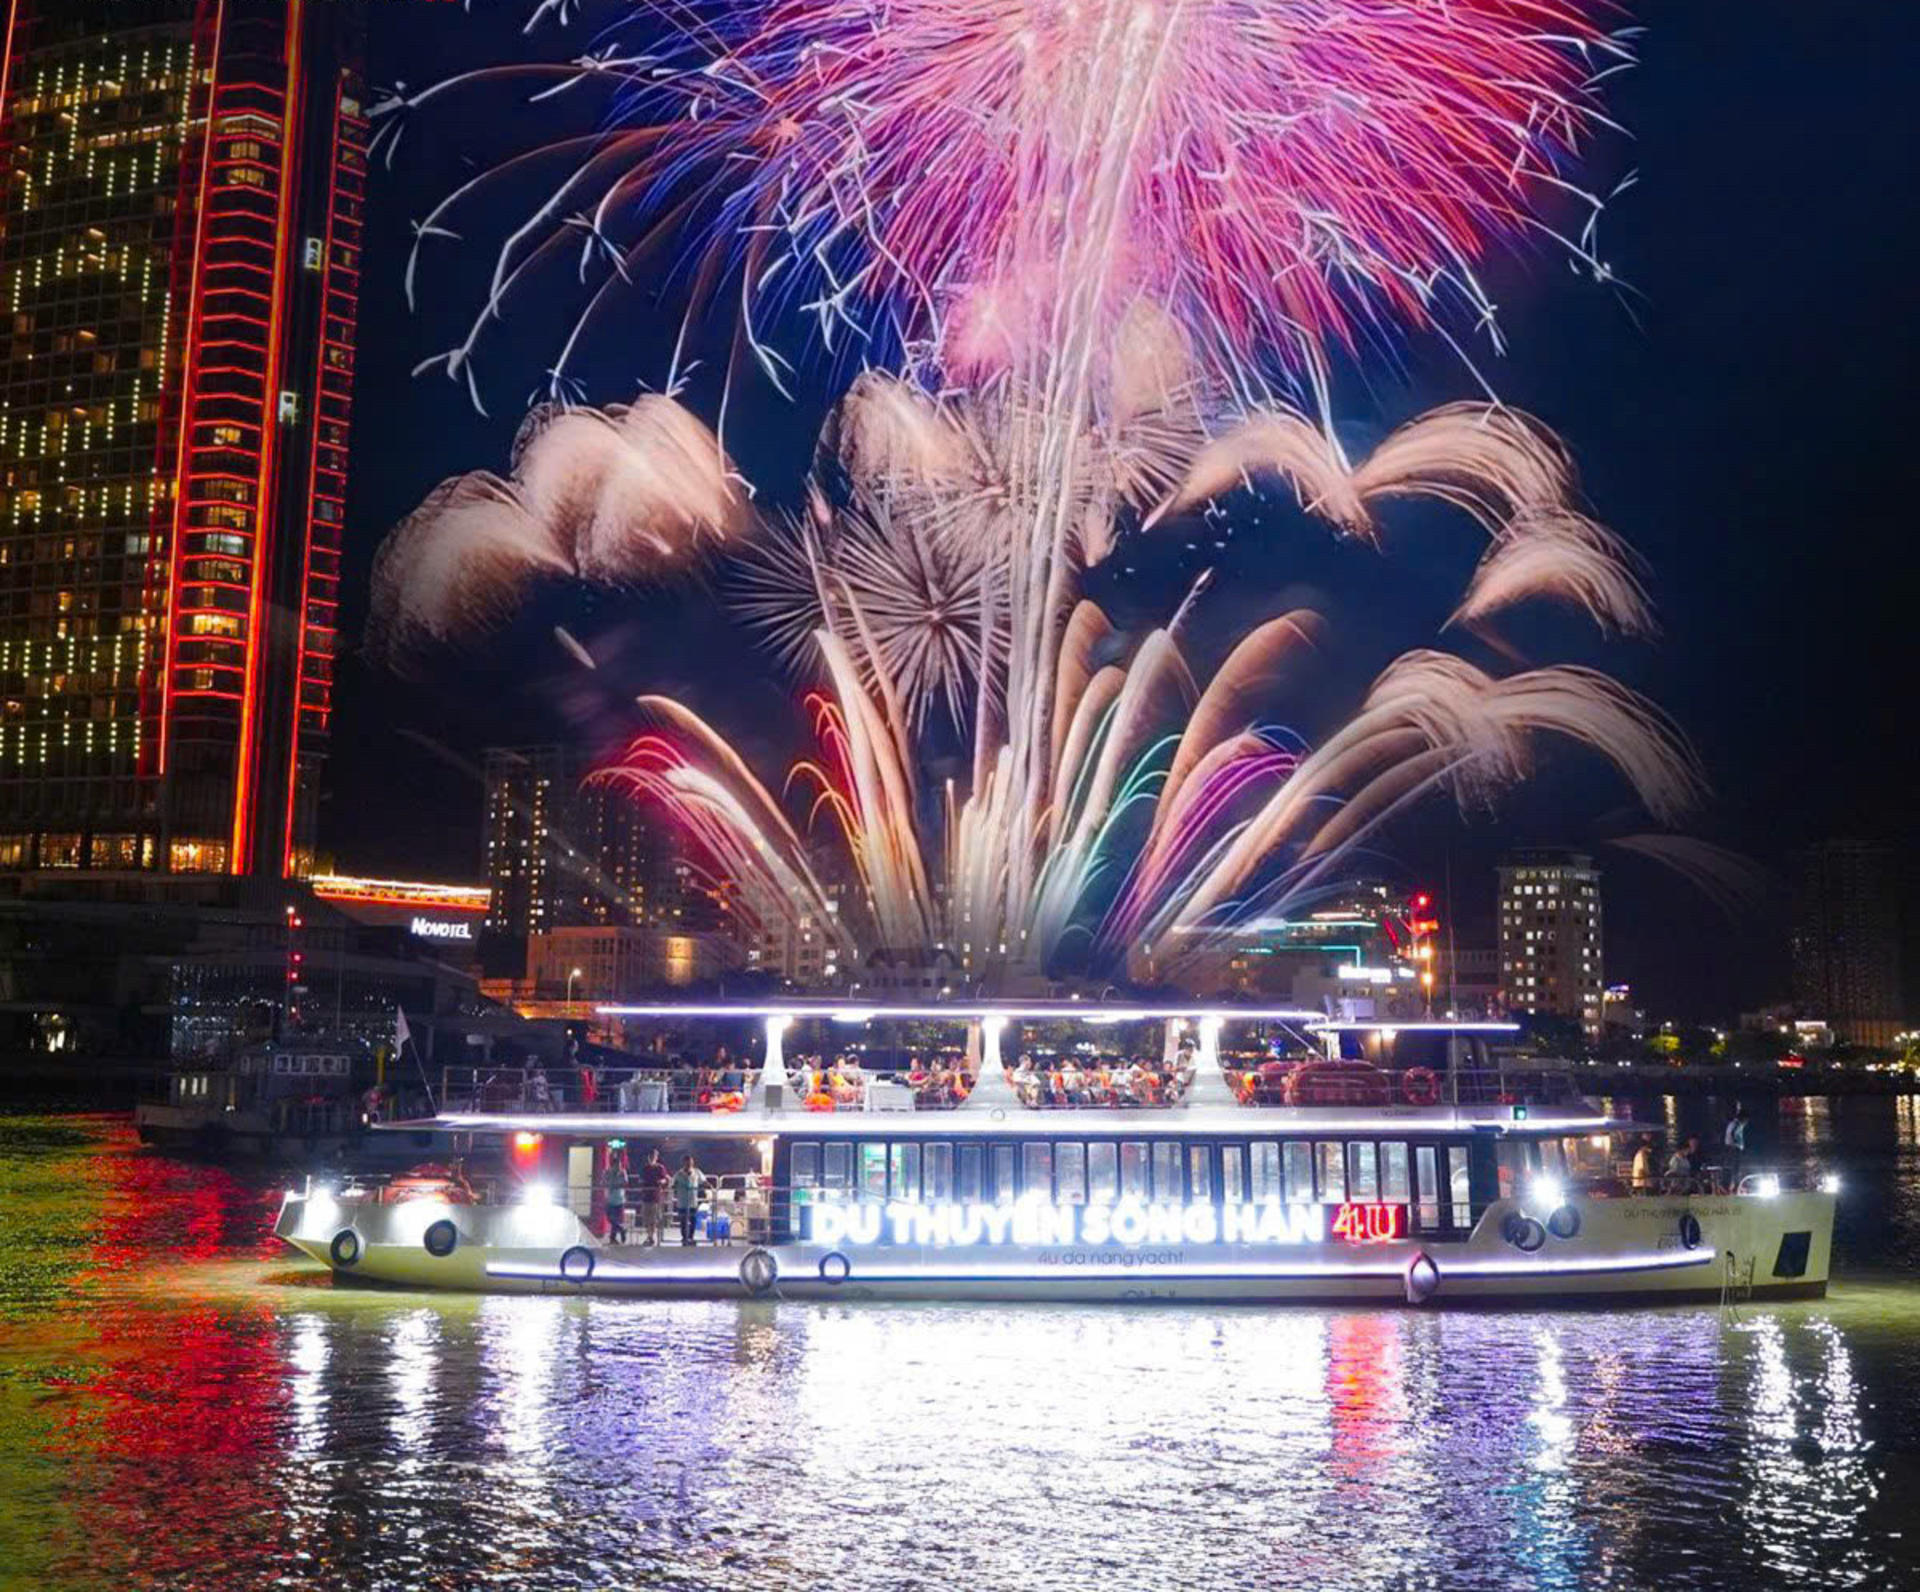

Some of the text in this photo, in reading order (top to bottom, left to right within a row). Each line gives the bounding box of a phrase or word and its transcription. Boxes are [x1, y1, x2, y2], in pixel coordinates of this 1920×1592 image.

[411, 917, 472, 939] NOVOTEL
[815, 1203, 878, 1244] DU
[1332, 1203, 1398, 1241] 4U
[1037, 1250, 1058, 1265] 4u
[1062, 1250, 1086, 1265] da
